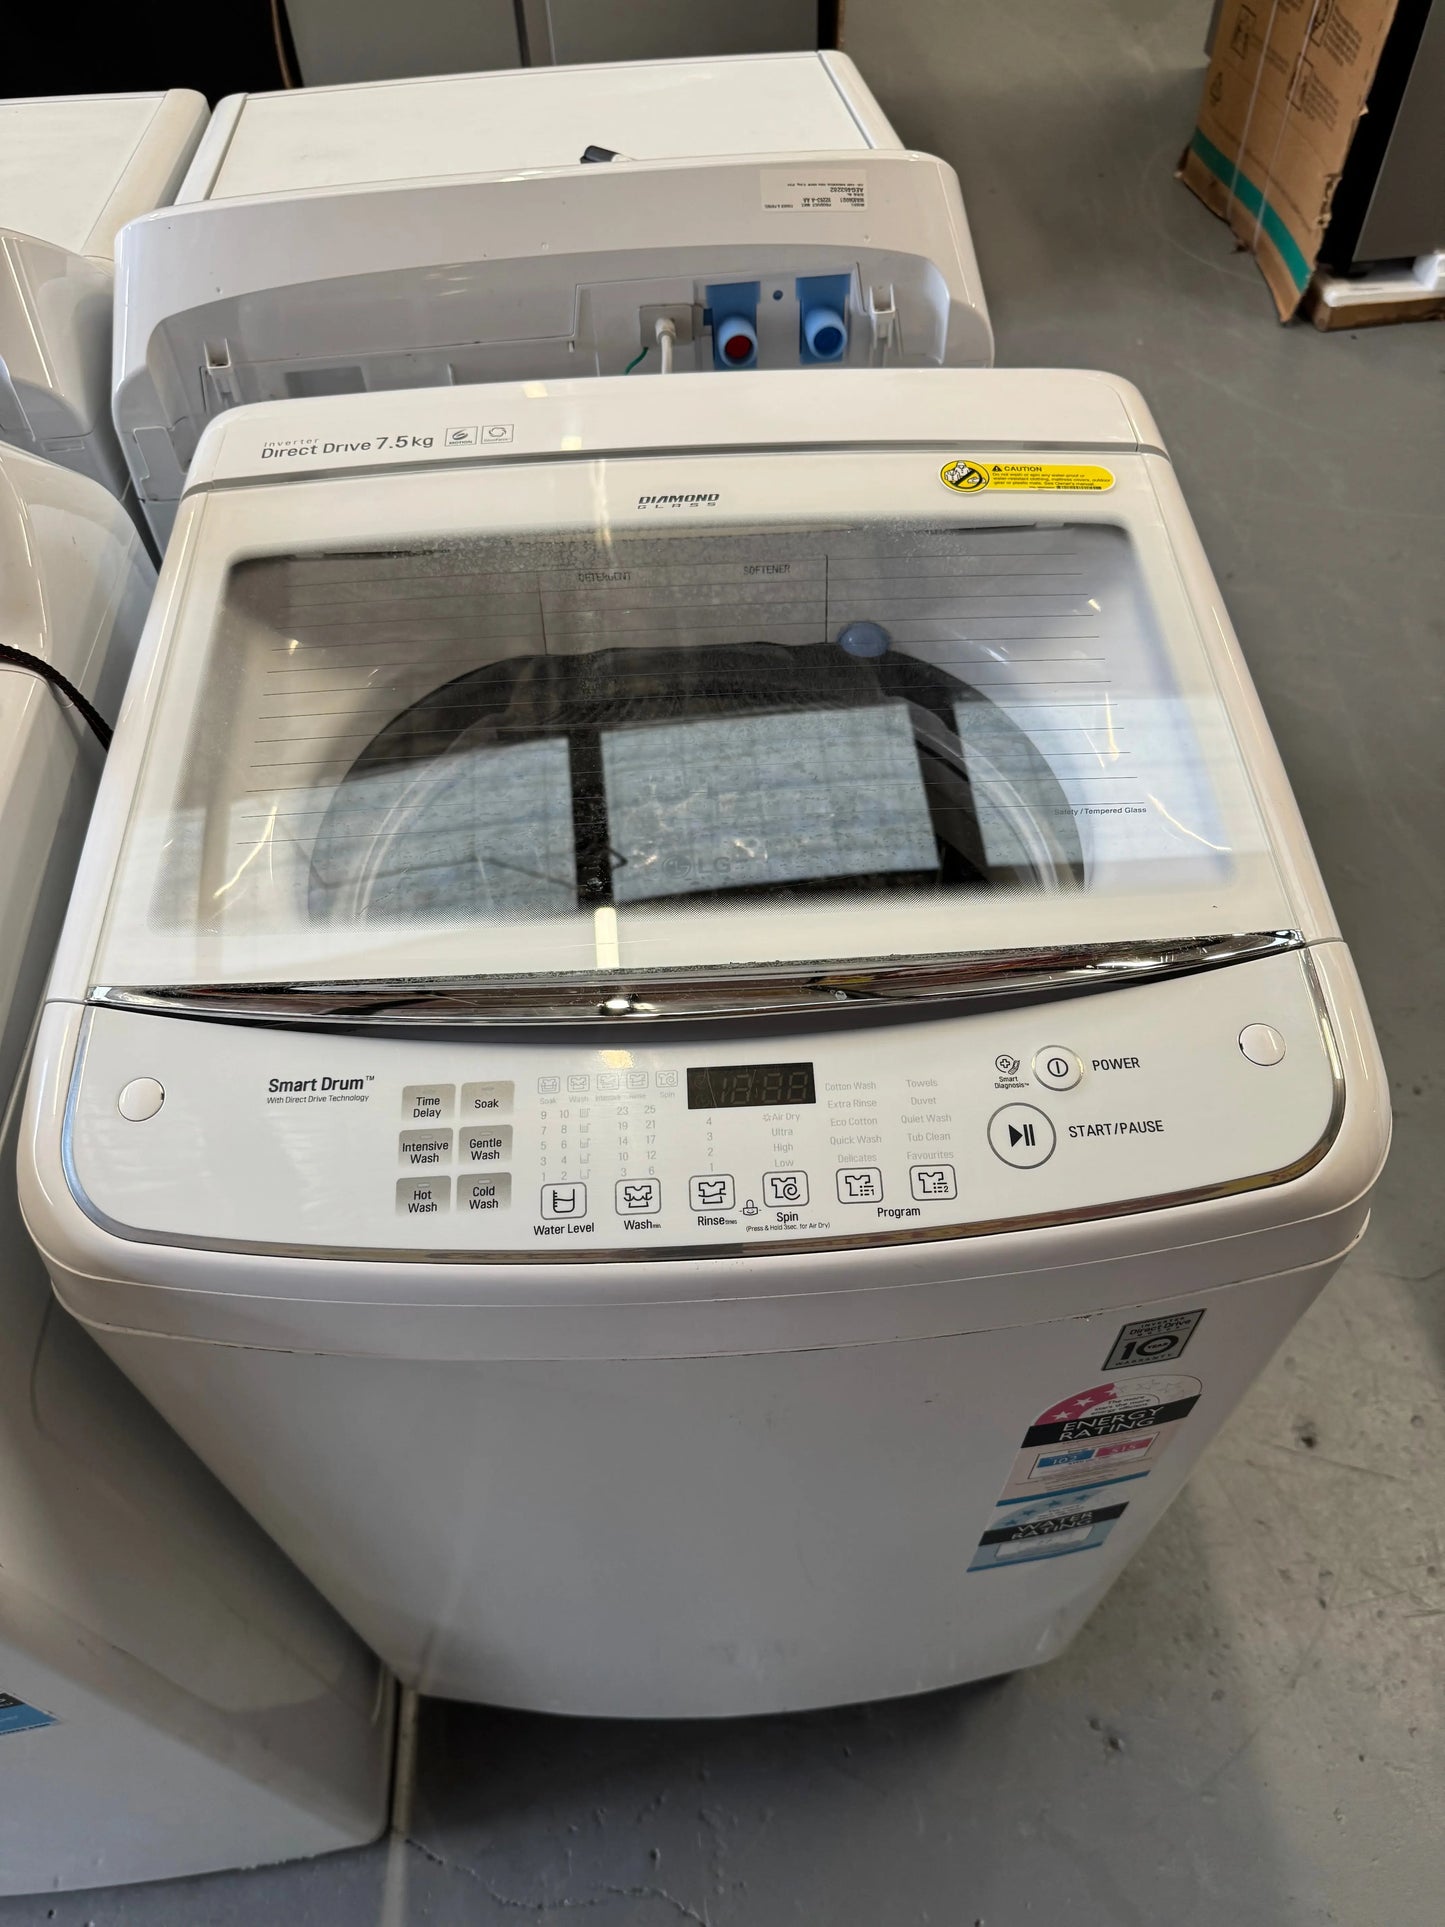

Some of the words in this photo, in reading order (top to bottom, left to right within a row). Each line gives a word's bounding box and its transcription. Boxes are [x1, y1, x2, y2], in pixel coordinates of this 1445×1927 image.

[261, 444, 318, 459] Direct
[322, 441, 371, 454] Drive
[638, 494, 720, 504] DIAMOND
[637, 502, 716, 510] GLASS
[743, 564, 791, 576] SOFTENER
[1054, 808, 1078, 816] Safety
[1085, 807, 1122, 815] Tempered
[697, 857, 731, 873] LG
[1092, 1057, 1141, 1071] POWER
[268, 1078, 317, 1093] Smart
[825, 1082, 852, 1092] Cotton
[853, 1081, 877, 1090] Wash
[905, 1078, 938, 1088] Towels
[267, 1096, 284, 1104] With
[285, 1095, 306, 1104] Direct
[307, 1095, 327, 1103] Drive
[328, 1094, 370, 1104] Technology
[416, 1096, 441, 1106] Time
[474, 1098, 499, 1109] Soak
[827, 1100, 850, 1109] Extra
[853, 1099, 877, 1108] Rinse
[910, 1096, 936, 1106] Duvet
[412, 1108, 442, 1119] Delay
[540, 1111, 547, 1119] 9
[560, 1109, 570, 1118] 10
[617, 1106, 629, 1115] 23
[644, 1105, 656, 1114] 25
[706, 1117, 713, 1126] 4
[772, 1112, 784, 1121] Air
[785, 1111, 800, 1121] Dry
[830, 1118, 846, 1127] Eco
[850, 1116, 878, 1126] Cotton
[900, 1115, 925, 1125] Quiet
[926, 1113, 952, 1123] Wash
[541, 1126, 547, 1135] 7
[560, 1125, 567, 1134] 8
[618, 1121, 628, 1130] 19
[645, 1120, 656, 1129] 21
[1068, 1120, 1165, 1138] START/PAUSE
[706, 1132, 713, 1141] 3
[771, 1127, 793, 1137] Ultra
[907, 1133, 924, 1142] Tub
[925, 1132, 951, 1142] Clean
[402, 1140, 449, 1152] Intensive
[469, 1137, 502, 1149] Gentle
[540, 1141, 547, 1150] 5
[560, 1140, 567, 1149] 6
[618, 1136, 628, 1146] 14
[646, 1135, 656, 1144] 17
[829, 1136, 855, 1146] Quick
[857, 1135, 882, 1144] Wash
[707, 1147, 714, 1157] 2
[773, 1143, 794, 1153] High
[410, 1153, 440, 1164] Wash
[471, 1150, 500, 1161] Wash
[540, 1157, 547, 1166] 3
[560, 1156, 567, 1164] 4
[618, 1152, 629, 1161] 10
[646, 1151, 657, 1160] 12
[837, 1154, 877, 1163] Delicates
[906, 1151, 954, 1161] Favourites
[709, 1163, 714, 1172] 1
[774, 1159, 794, 1168] Low
[541, 1172, 546, 1182] 1
[560, 1171, 567, 1180] 2
[620, 1167, 627, 1177] 3
[648, 1166, 655, 1175] 6
[413, 1189, 432, 1201] Hot
[472, 1186, 496, 1197] Cold
[408, 1202, 438, 1213] Wash
[469, 1198, 499, 1210] Wash
[776, 1211, 799, 1223] Spin
[877, 1206, 921, 1219] Program
[623, 1219, 653, 1230] Wash
[697, 1215, 725, 1226] Rinse
[784, 1223, 798, 1231] 3sec.
[818, 1221, 831, 1229] Dry)
[533, 1225, 565, 1236] Water
[567, 1222, 595, 1234] Level
[1129, 1324, 1162, 1335] Direct
[1163, 1319, 1192, 1329] Drive
[1120, 1334, 1179, 1360] 10
[1063, 1406, 1165, 1431] ENERGY
[1059, 1417, 1155, 1440] RATING
[1018, 1511, 1093, 1532] WATER
[1011, 1520, 1092, 1540] RATING
